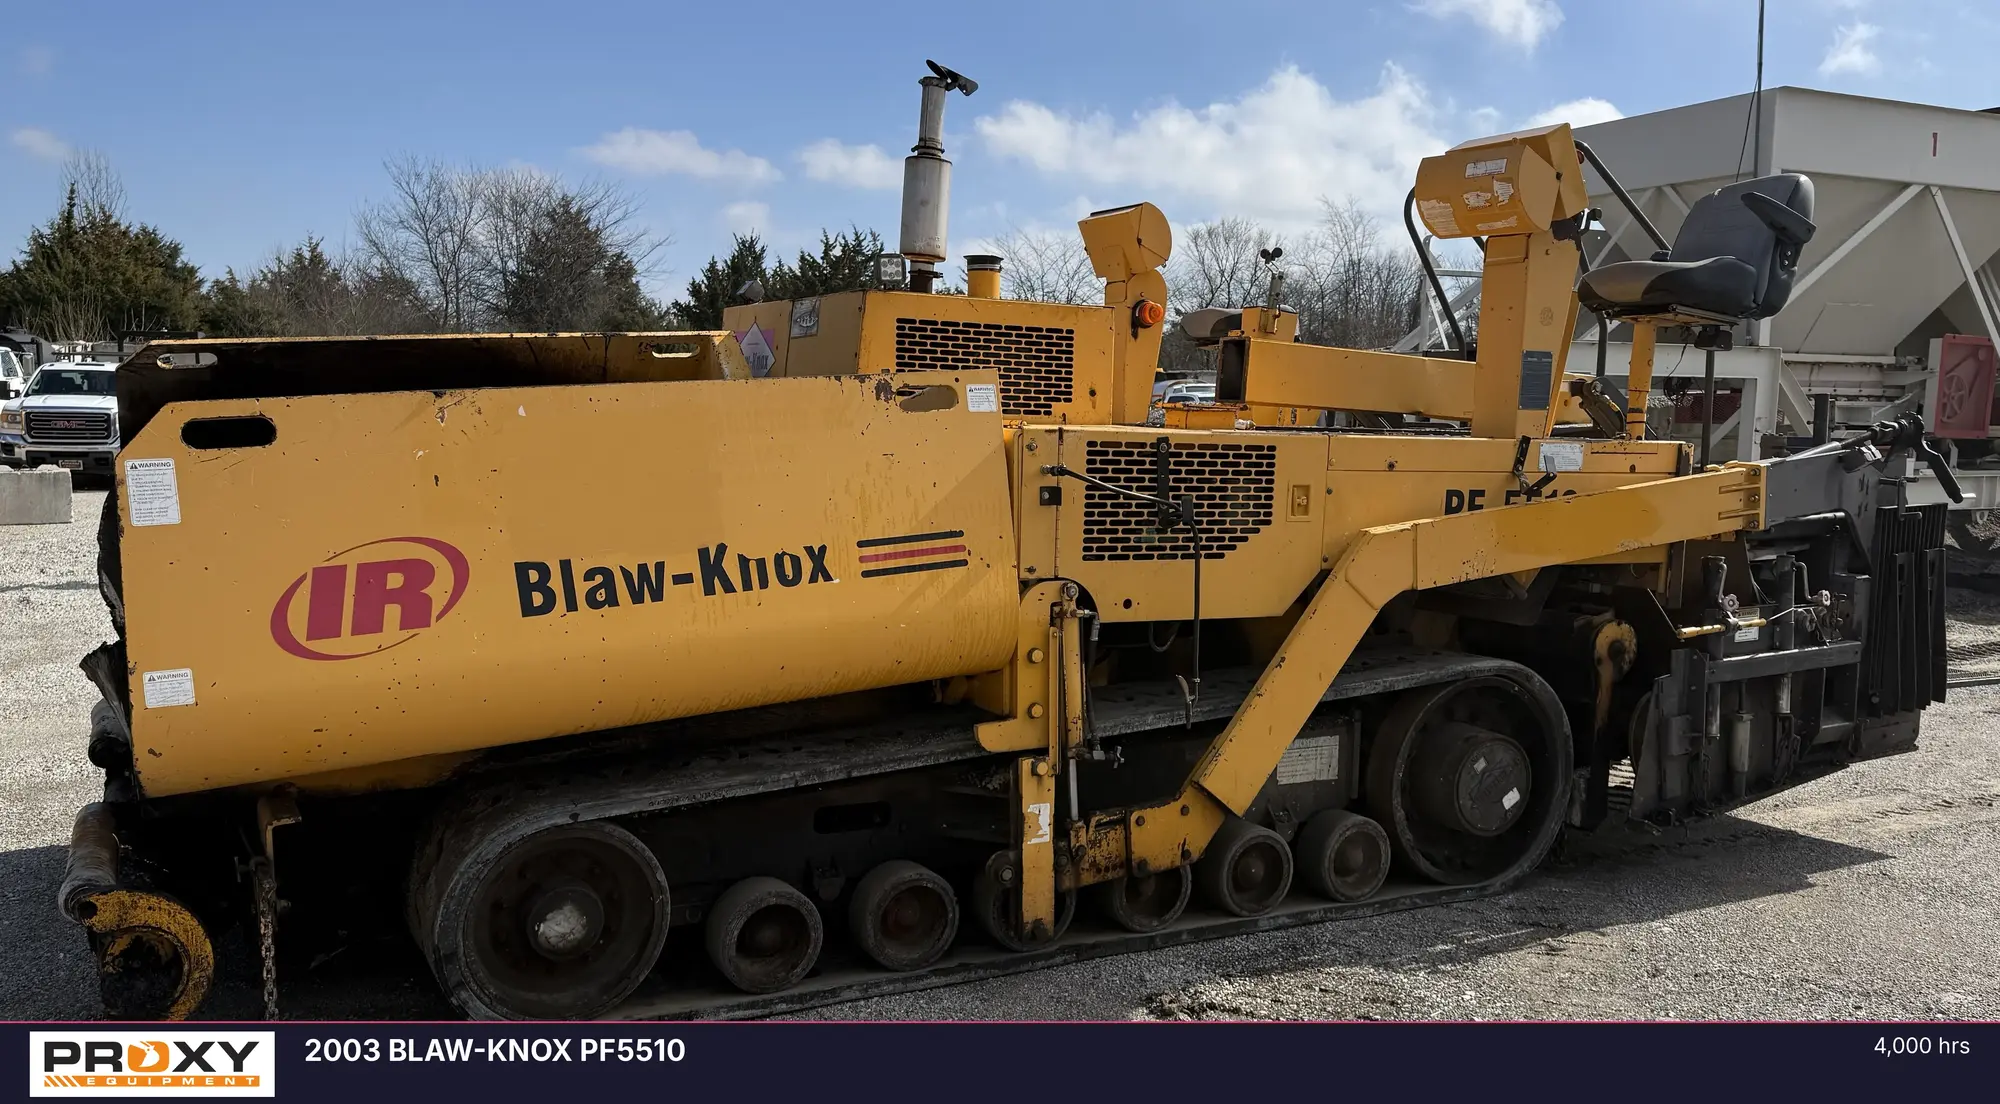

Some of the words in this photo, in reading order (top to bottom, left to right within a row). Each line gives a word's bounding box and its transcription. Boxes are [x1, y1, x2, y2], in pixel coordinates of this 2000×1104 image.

[1932, 132, 1938, 157] 1
[51, 420, 86, 429] GMC
[514, 543, 834, 618] Blaw-Knox
[306, 558, 436, 642] IR
[156, 672, 189, 681] WARNING
